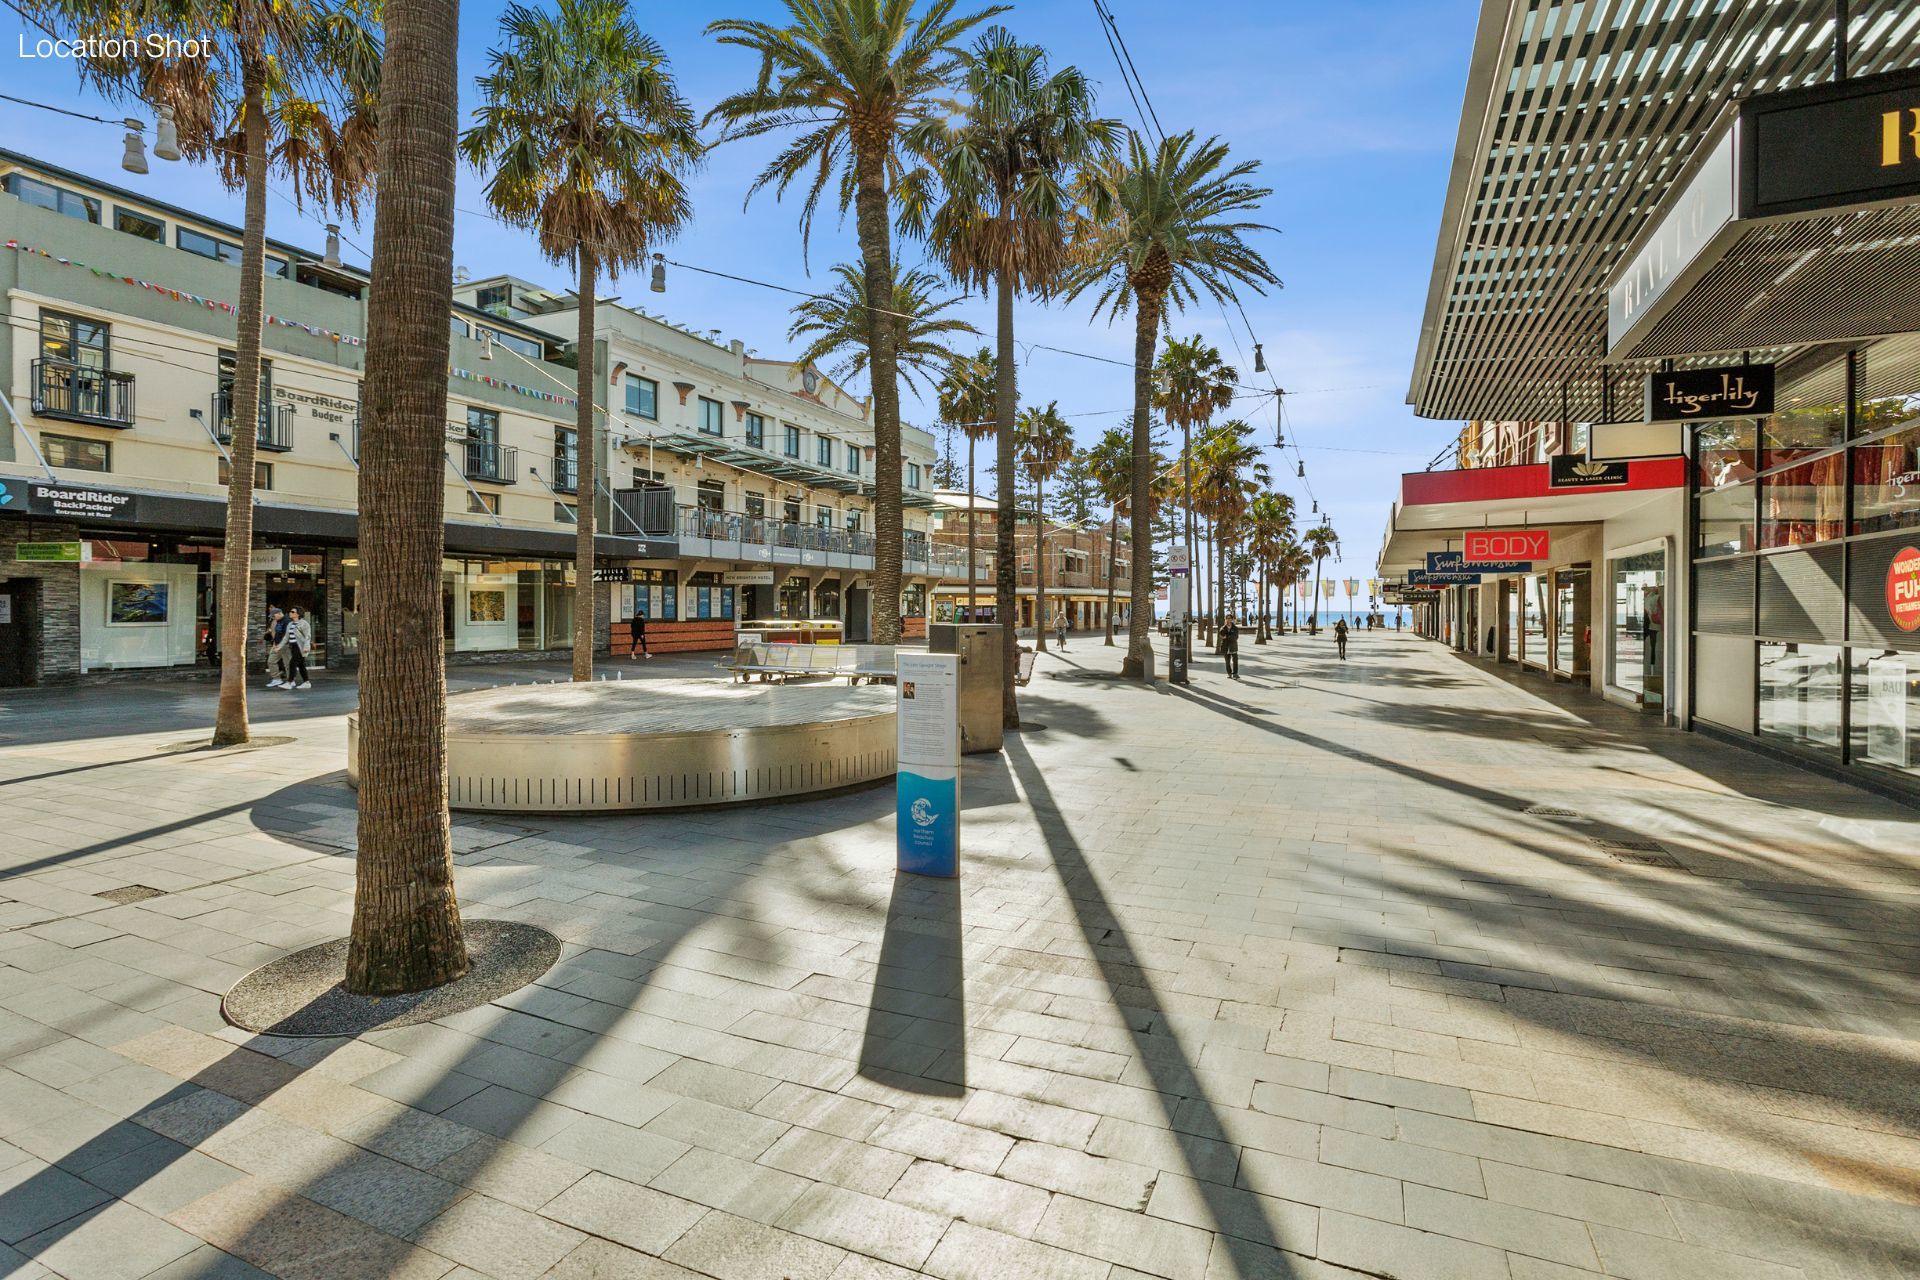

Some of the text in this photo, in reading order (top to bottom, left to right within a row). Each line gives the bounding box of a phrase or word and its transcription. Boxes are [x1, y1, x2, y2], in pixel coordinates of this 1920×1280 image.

[275, 387, 357, 412] BoardRider
[1663, 373, 1759, 414] tigerlily
[311, 408, 343, 423] Budget
[36, 486, 129, 505] BoardRider
[53, 500, 115, 512] BackPacker
[55, 508, 87, 517] Entrance
[1472, 536, 1545, 556] BODY
